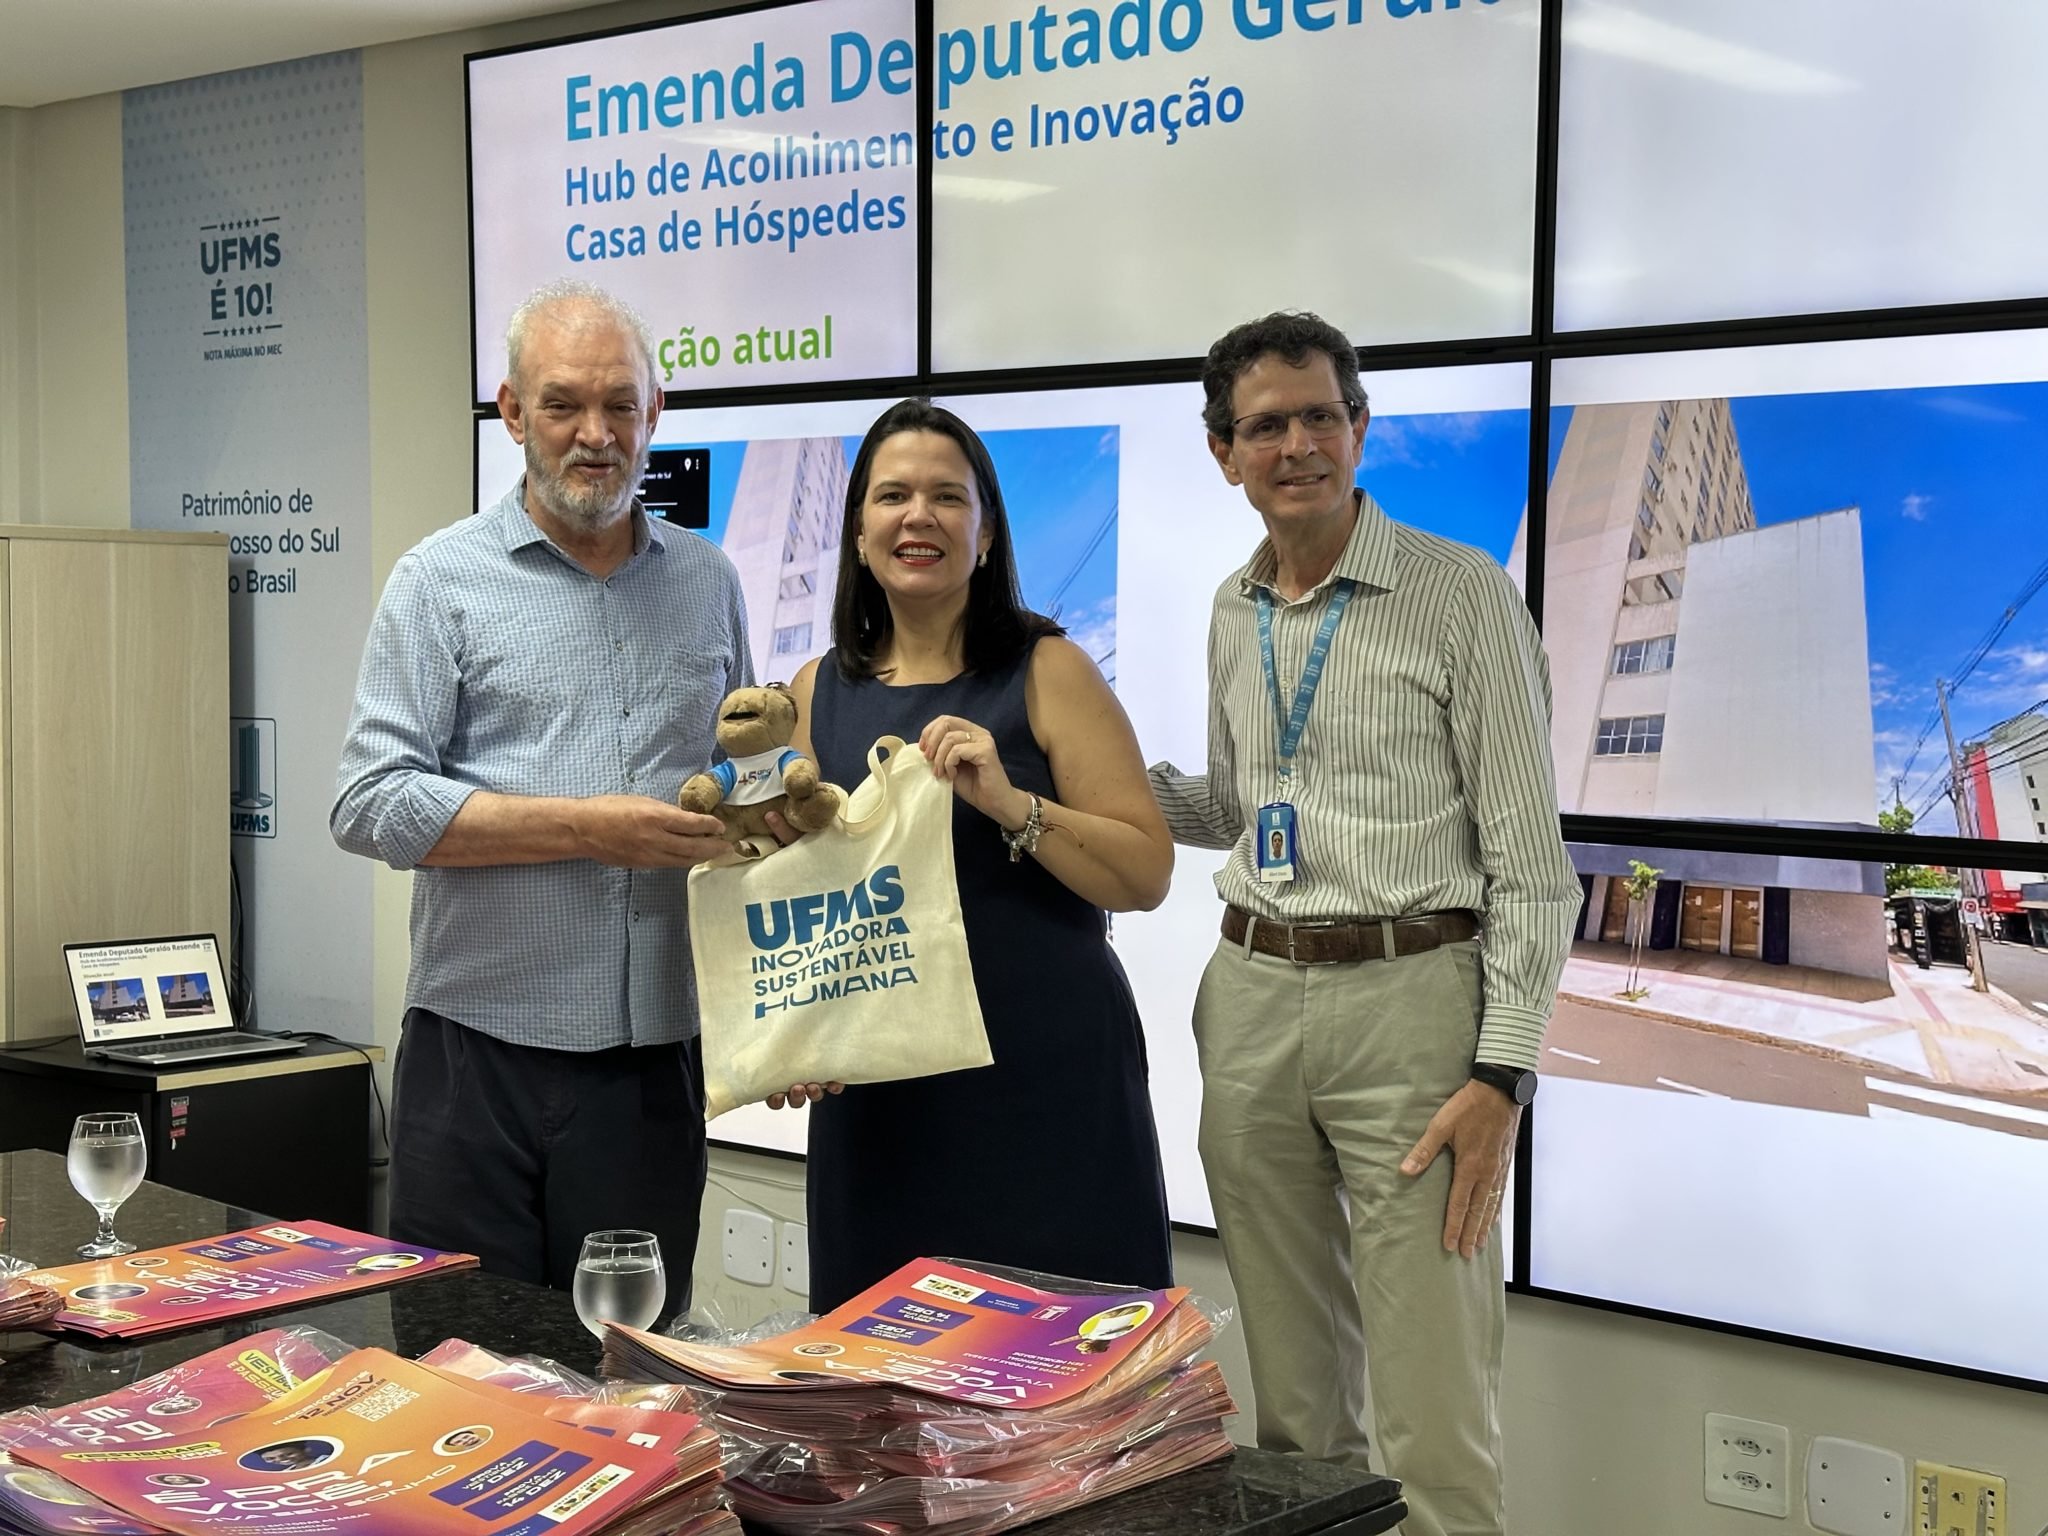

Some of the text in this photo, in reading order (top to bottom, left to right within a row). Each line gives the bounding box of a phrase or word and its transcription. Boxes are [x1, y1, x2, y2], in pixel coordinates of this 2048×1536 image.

[566, 42, 805, 141] Emenda
[566, 77, 1244, 206] Hub de Acolhimento e Inovação
[566, 188, 906, 262] Casa de Hóspedes
[201, 232, 281, 275] UFMS
[211, 279, 272, 320] É 10!
[204, 344, 282, 361] NOTA MÁXIMA NO MEC
[658, 315, 832, 382] ção atual
[182, 488, 313, 517] Patrimônio de
[230, 526, 340, 554] osso do Sul
[229, 568, 296, 593] o Brasil
[231, 812, 270, 833] UFMS
[745, 865, 905, 951] UFMS
[79, 949, 108, 959] Emenda
[109, 947, 143, 957] Deputado
[144, 943, 171, 953] Geraldo
[172, 942, 201, 951] Resende
[752, 916, 911, 974] INOVADORA
[754, 941, 915, 997] SUSTENTÁVEL
[754, 966, 918, 1020] HUMANA
[137, 1269, 226, 1294] PRA
[872, 1323, 907, 1332] DEZ
[902, 1303, 936, 1314] DEZ
[824, 1359, 957, 1390] PRA
[860, 1345, 1053, 1388] VIVA SEU SONHO
[298, 1374, 374, 1420] 12 NOV
[49, 1414, 126, 1446] VOC
[71, 1443, 211, 1458] VESTIBULAR
[223, 1450, 415, 1499] PRA
[487, 1461, 528, 1483] DEZ
[501, 1497, 523, 1506] 14
[525, 1470, 566, 1494] DEZ
[191, 1464, 456, 1523] VIVA SEU SONHO
